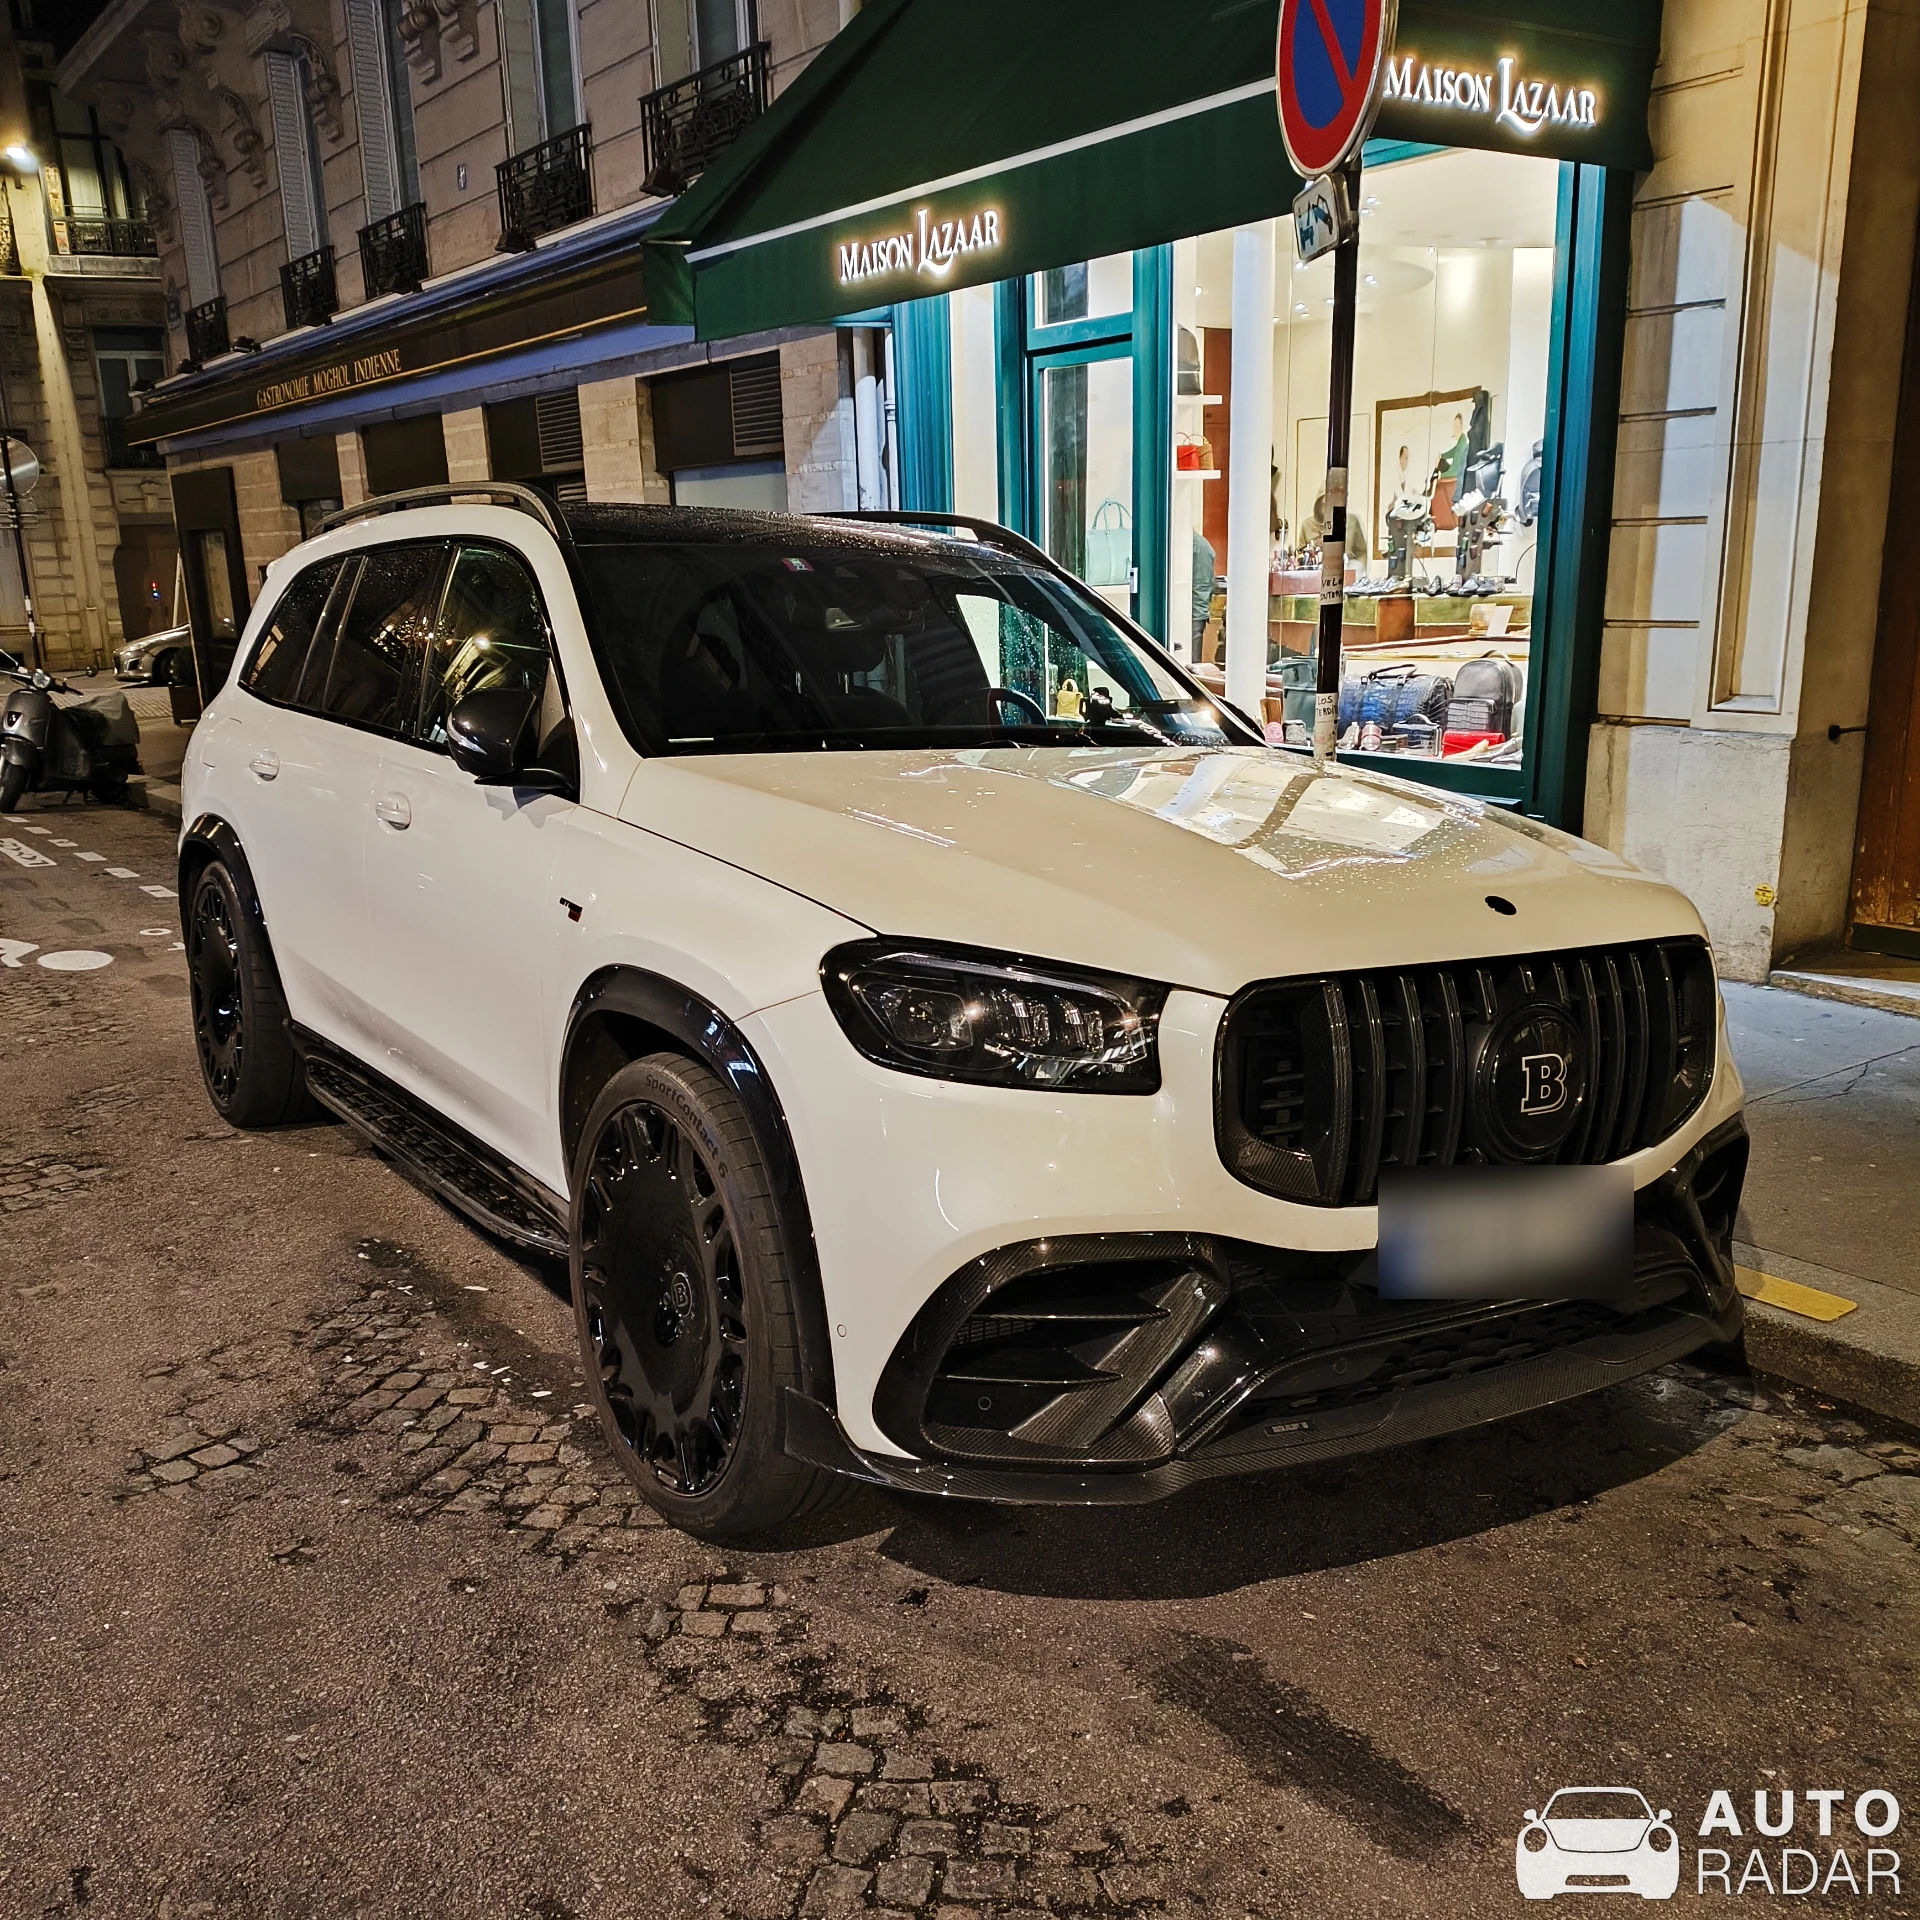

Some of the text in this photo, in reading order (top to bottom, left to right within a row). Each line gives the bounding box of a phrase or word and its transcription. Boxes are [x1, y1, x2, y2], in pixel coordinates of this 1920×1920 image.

[1383, 57, 1598, 132] MAISON LAZAAR
[840, 209, 999, 282] MAISON LAZAAR
[256, 348, 402, 410] GASTRONOMIE MOGHOL INDIENNE
[1521, 1053, 1567, 1116] B
[645, 1074, 729, 1179] SportContact 6
[673, 1282, 689, 1308] B
